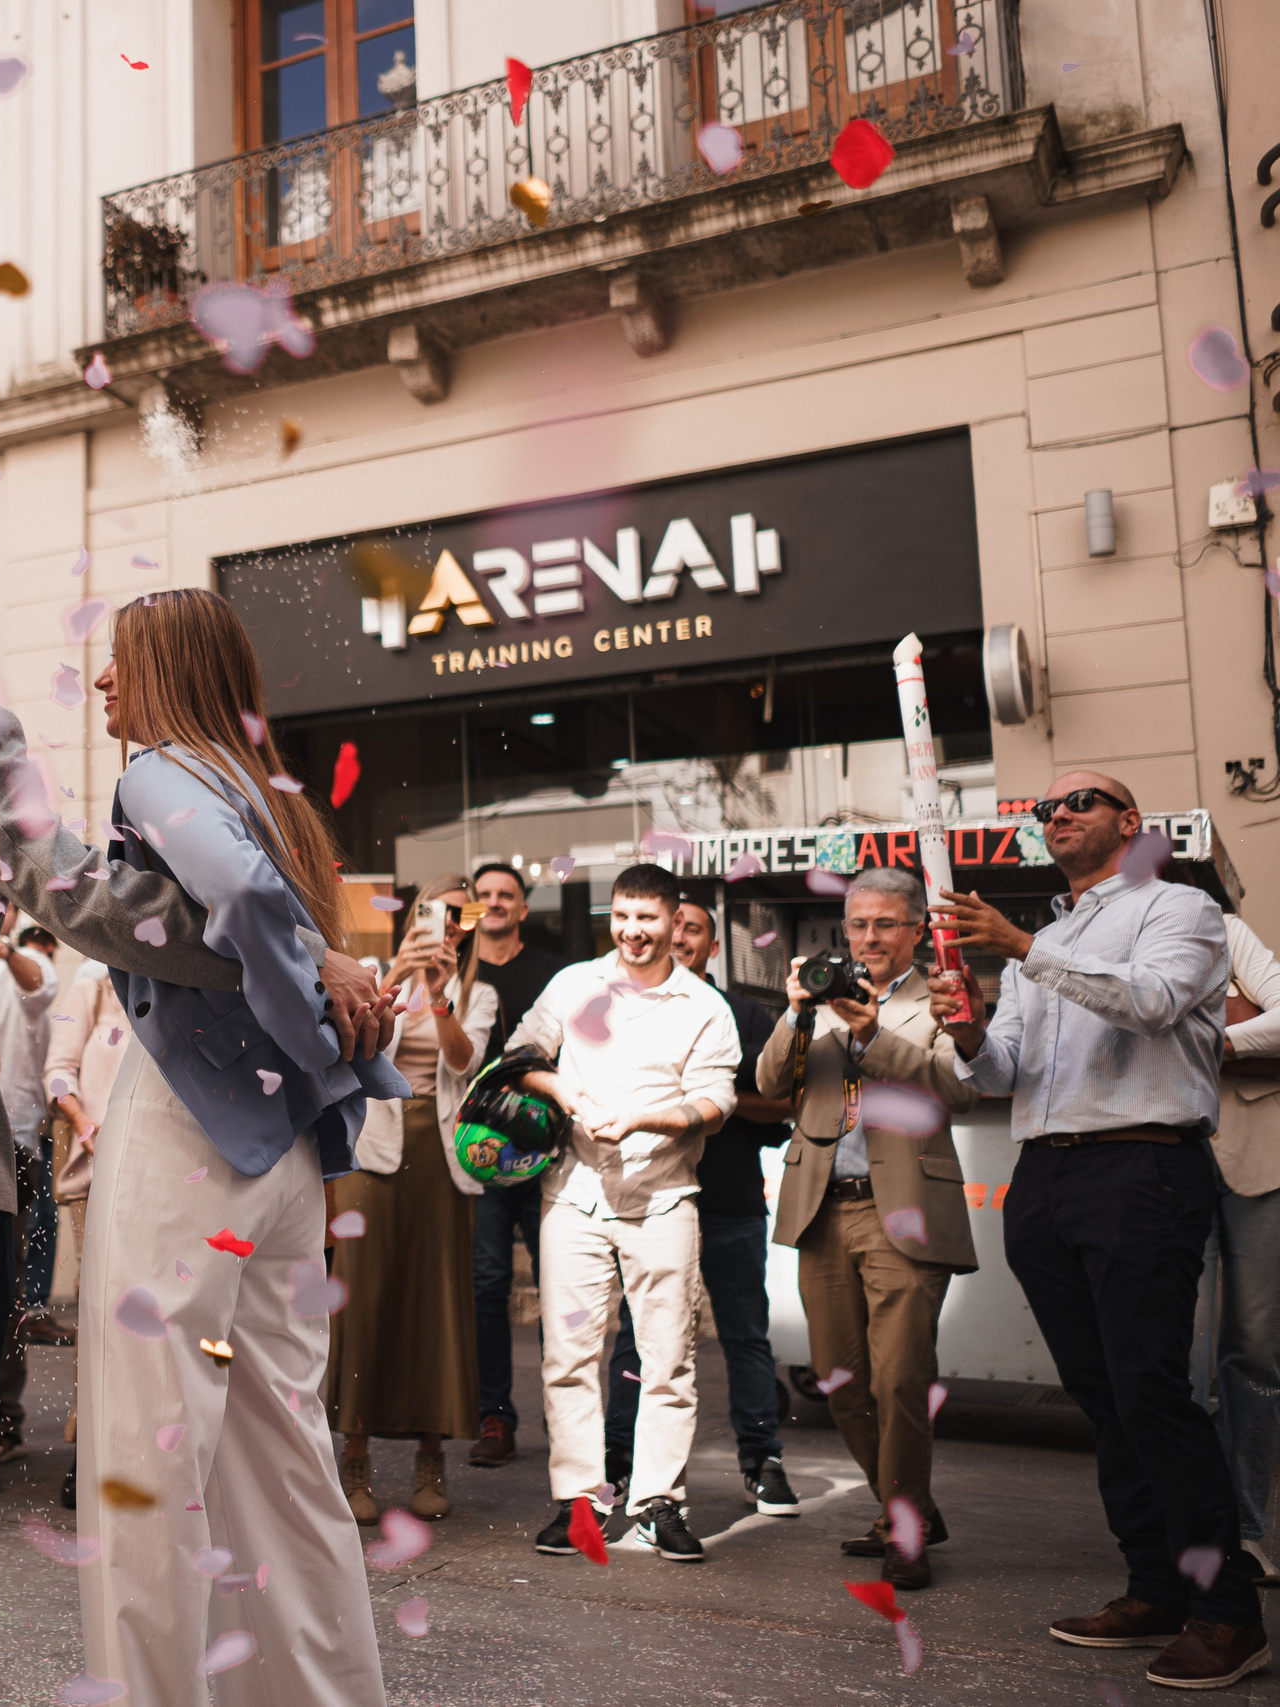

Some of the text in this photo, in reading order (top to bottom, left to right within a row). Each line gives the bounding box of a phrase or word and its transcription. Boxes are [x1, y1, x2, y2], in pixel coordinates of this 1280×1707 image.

[406, 516, 729, 636] ARENA
[431, 614, 715, 675] TRAINING CENTER
[856, 826, 1020, 868] AROZ
